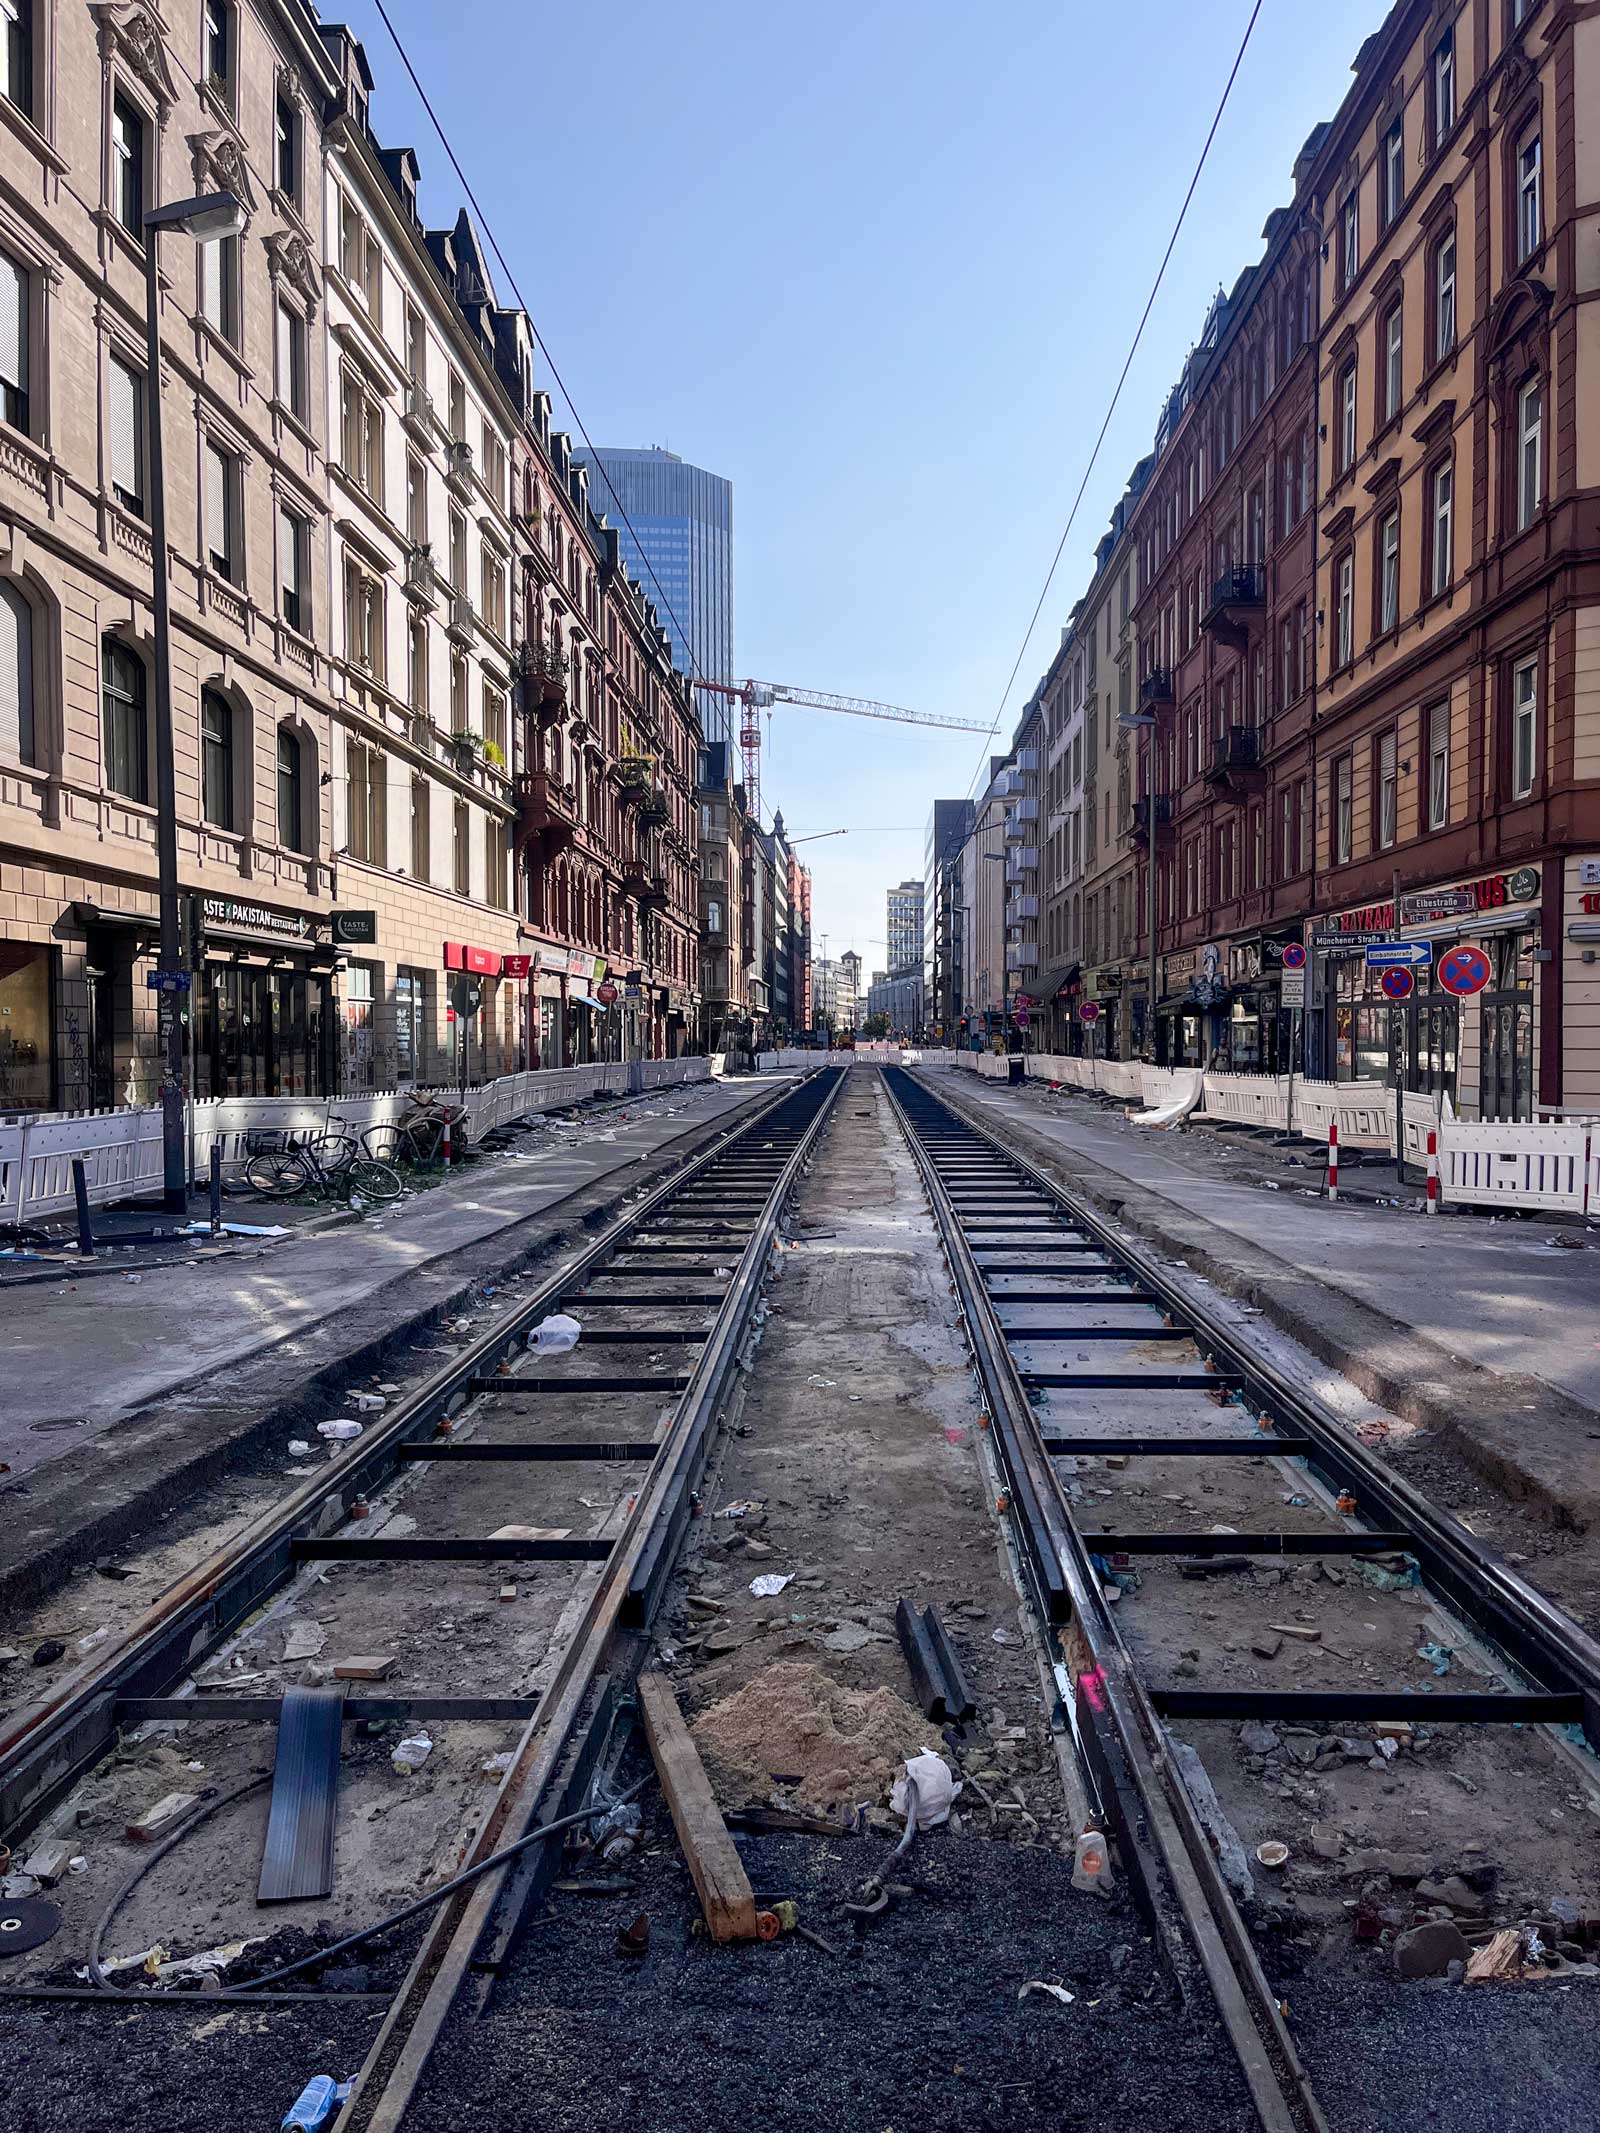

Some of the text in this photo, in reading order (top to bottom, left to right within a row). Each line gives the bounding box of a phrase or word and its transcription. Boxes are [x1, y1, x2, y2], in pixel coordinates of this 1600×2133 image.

[1416, 898, 1458, 908] Elbestraße
[203, 899, 225, 918] ASTE
[232, 904, 272, 926] PAKISTAN
[271, 918, 300, 932] RESTAURANT
[1341, 903, 1394, 931] BAYRAM
[1316, 934, 1381, 946] Münchener Straße
[1370, 950, 1413, 958] Einbahnstraße
